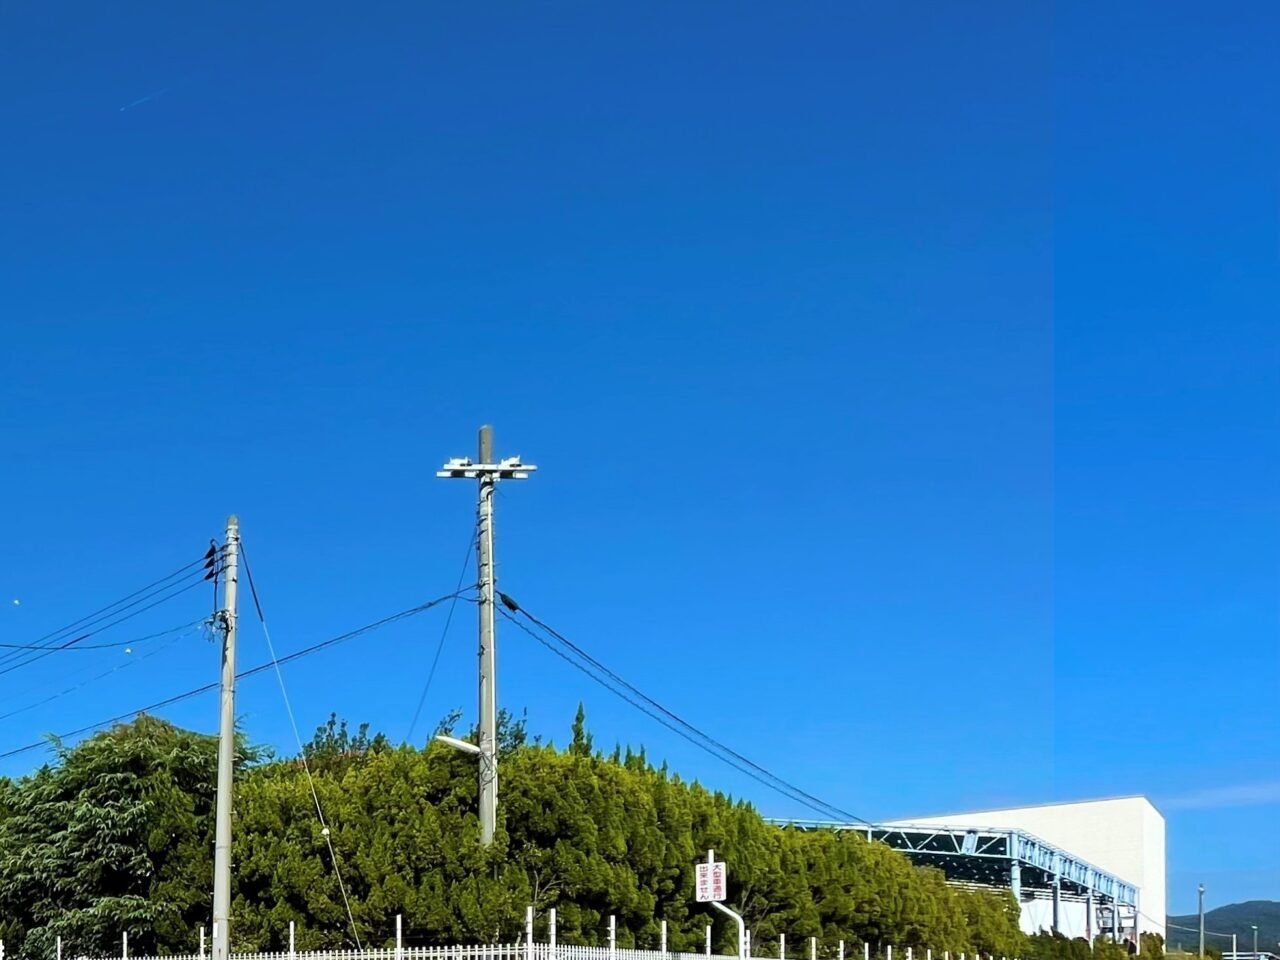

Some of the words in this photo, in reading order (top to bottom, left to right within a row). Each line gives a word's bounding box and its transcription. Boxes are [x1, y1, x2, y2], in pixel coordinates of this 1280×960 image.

[700, 866, 709, 900] 出来ません
[713, 864, 722, 899] 大型車通行
